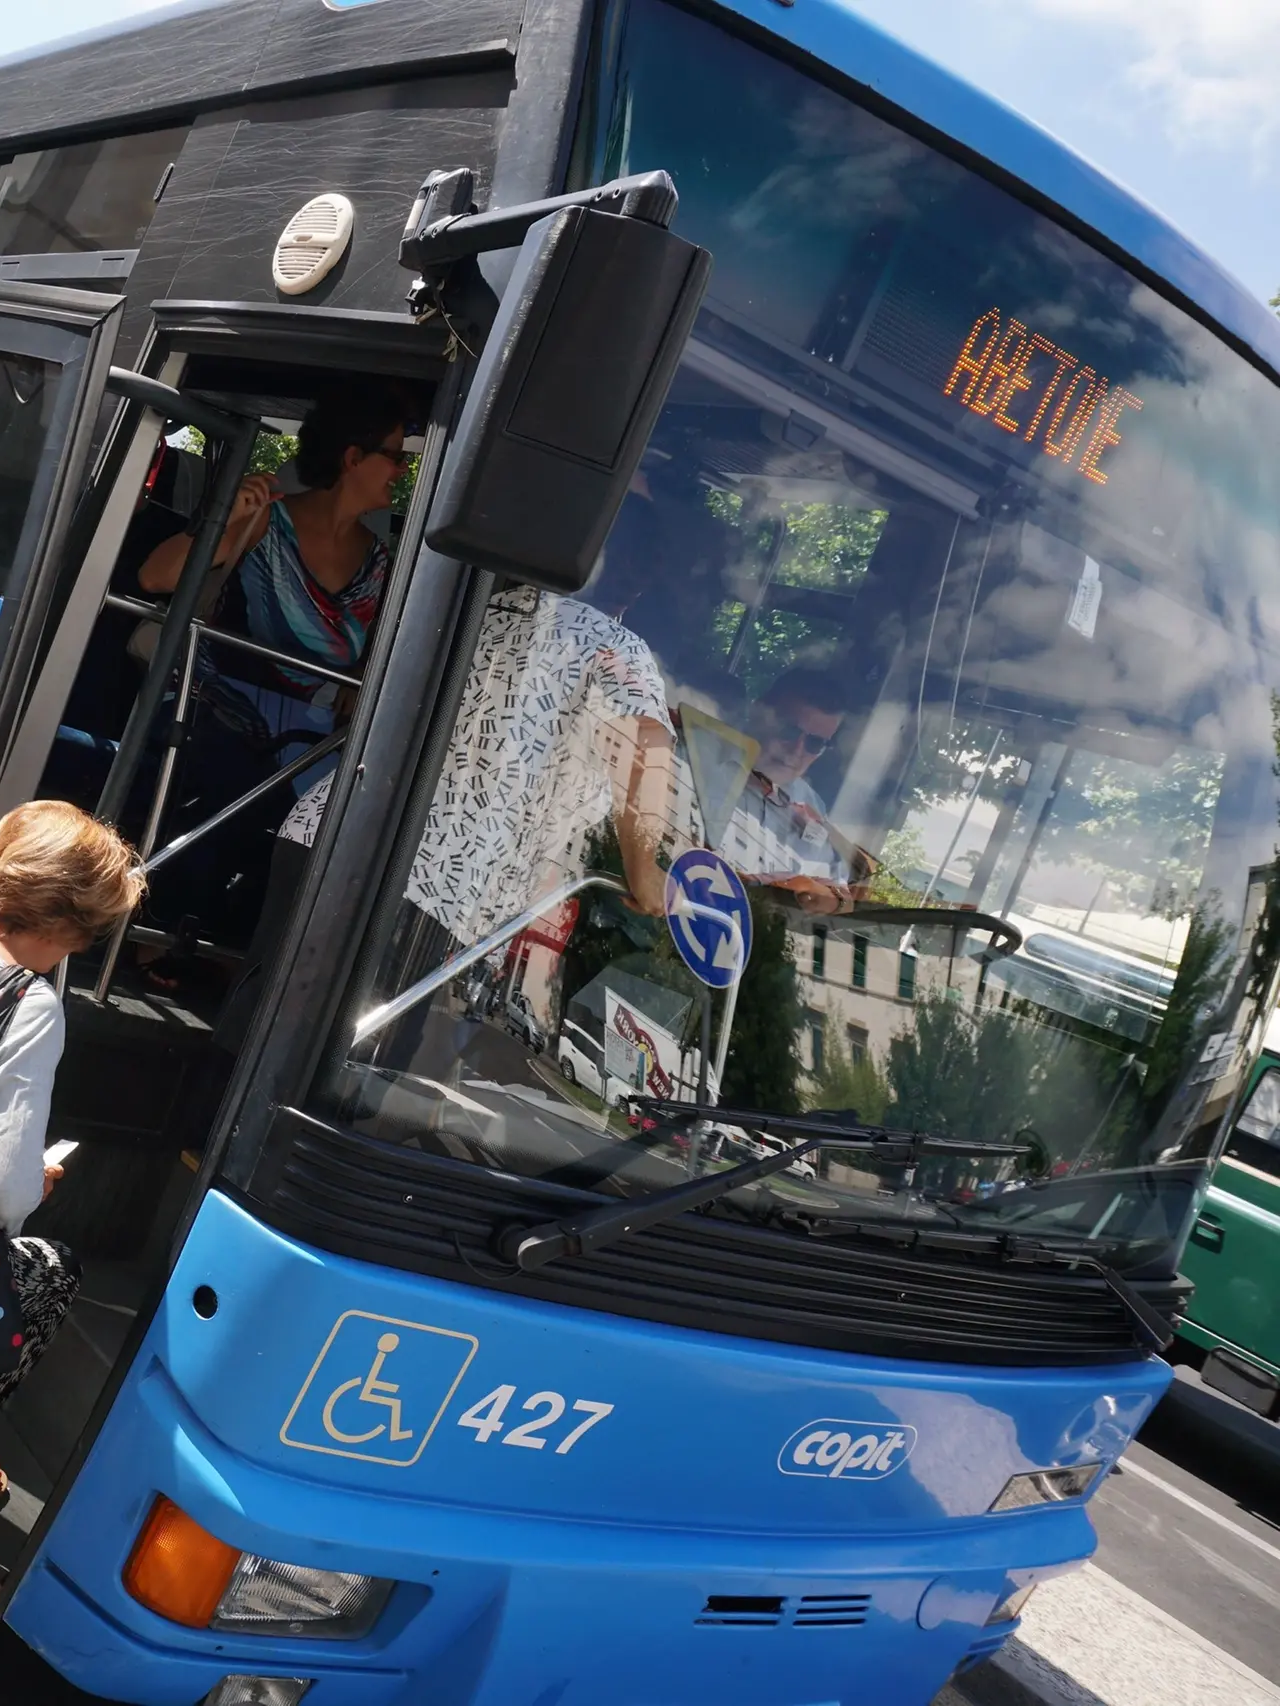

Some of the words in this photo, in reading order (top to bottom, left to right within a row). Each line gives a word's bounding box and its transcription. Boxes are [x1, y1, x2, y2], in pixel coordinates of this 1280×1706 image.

[943, 307, 1144, 484] ABETONE
[456, 1383, 615, 1454] 427
[793, 1430, 905, 1478] copit
